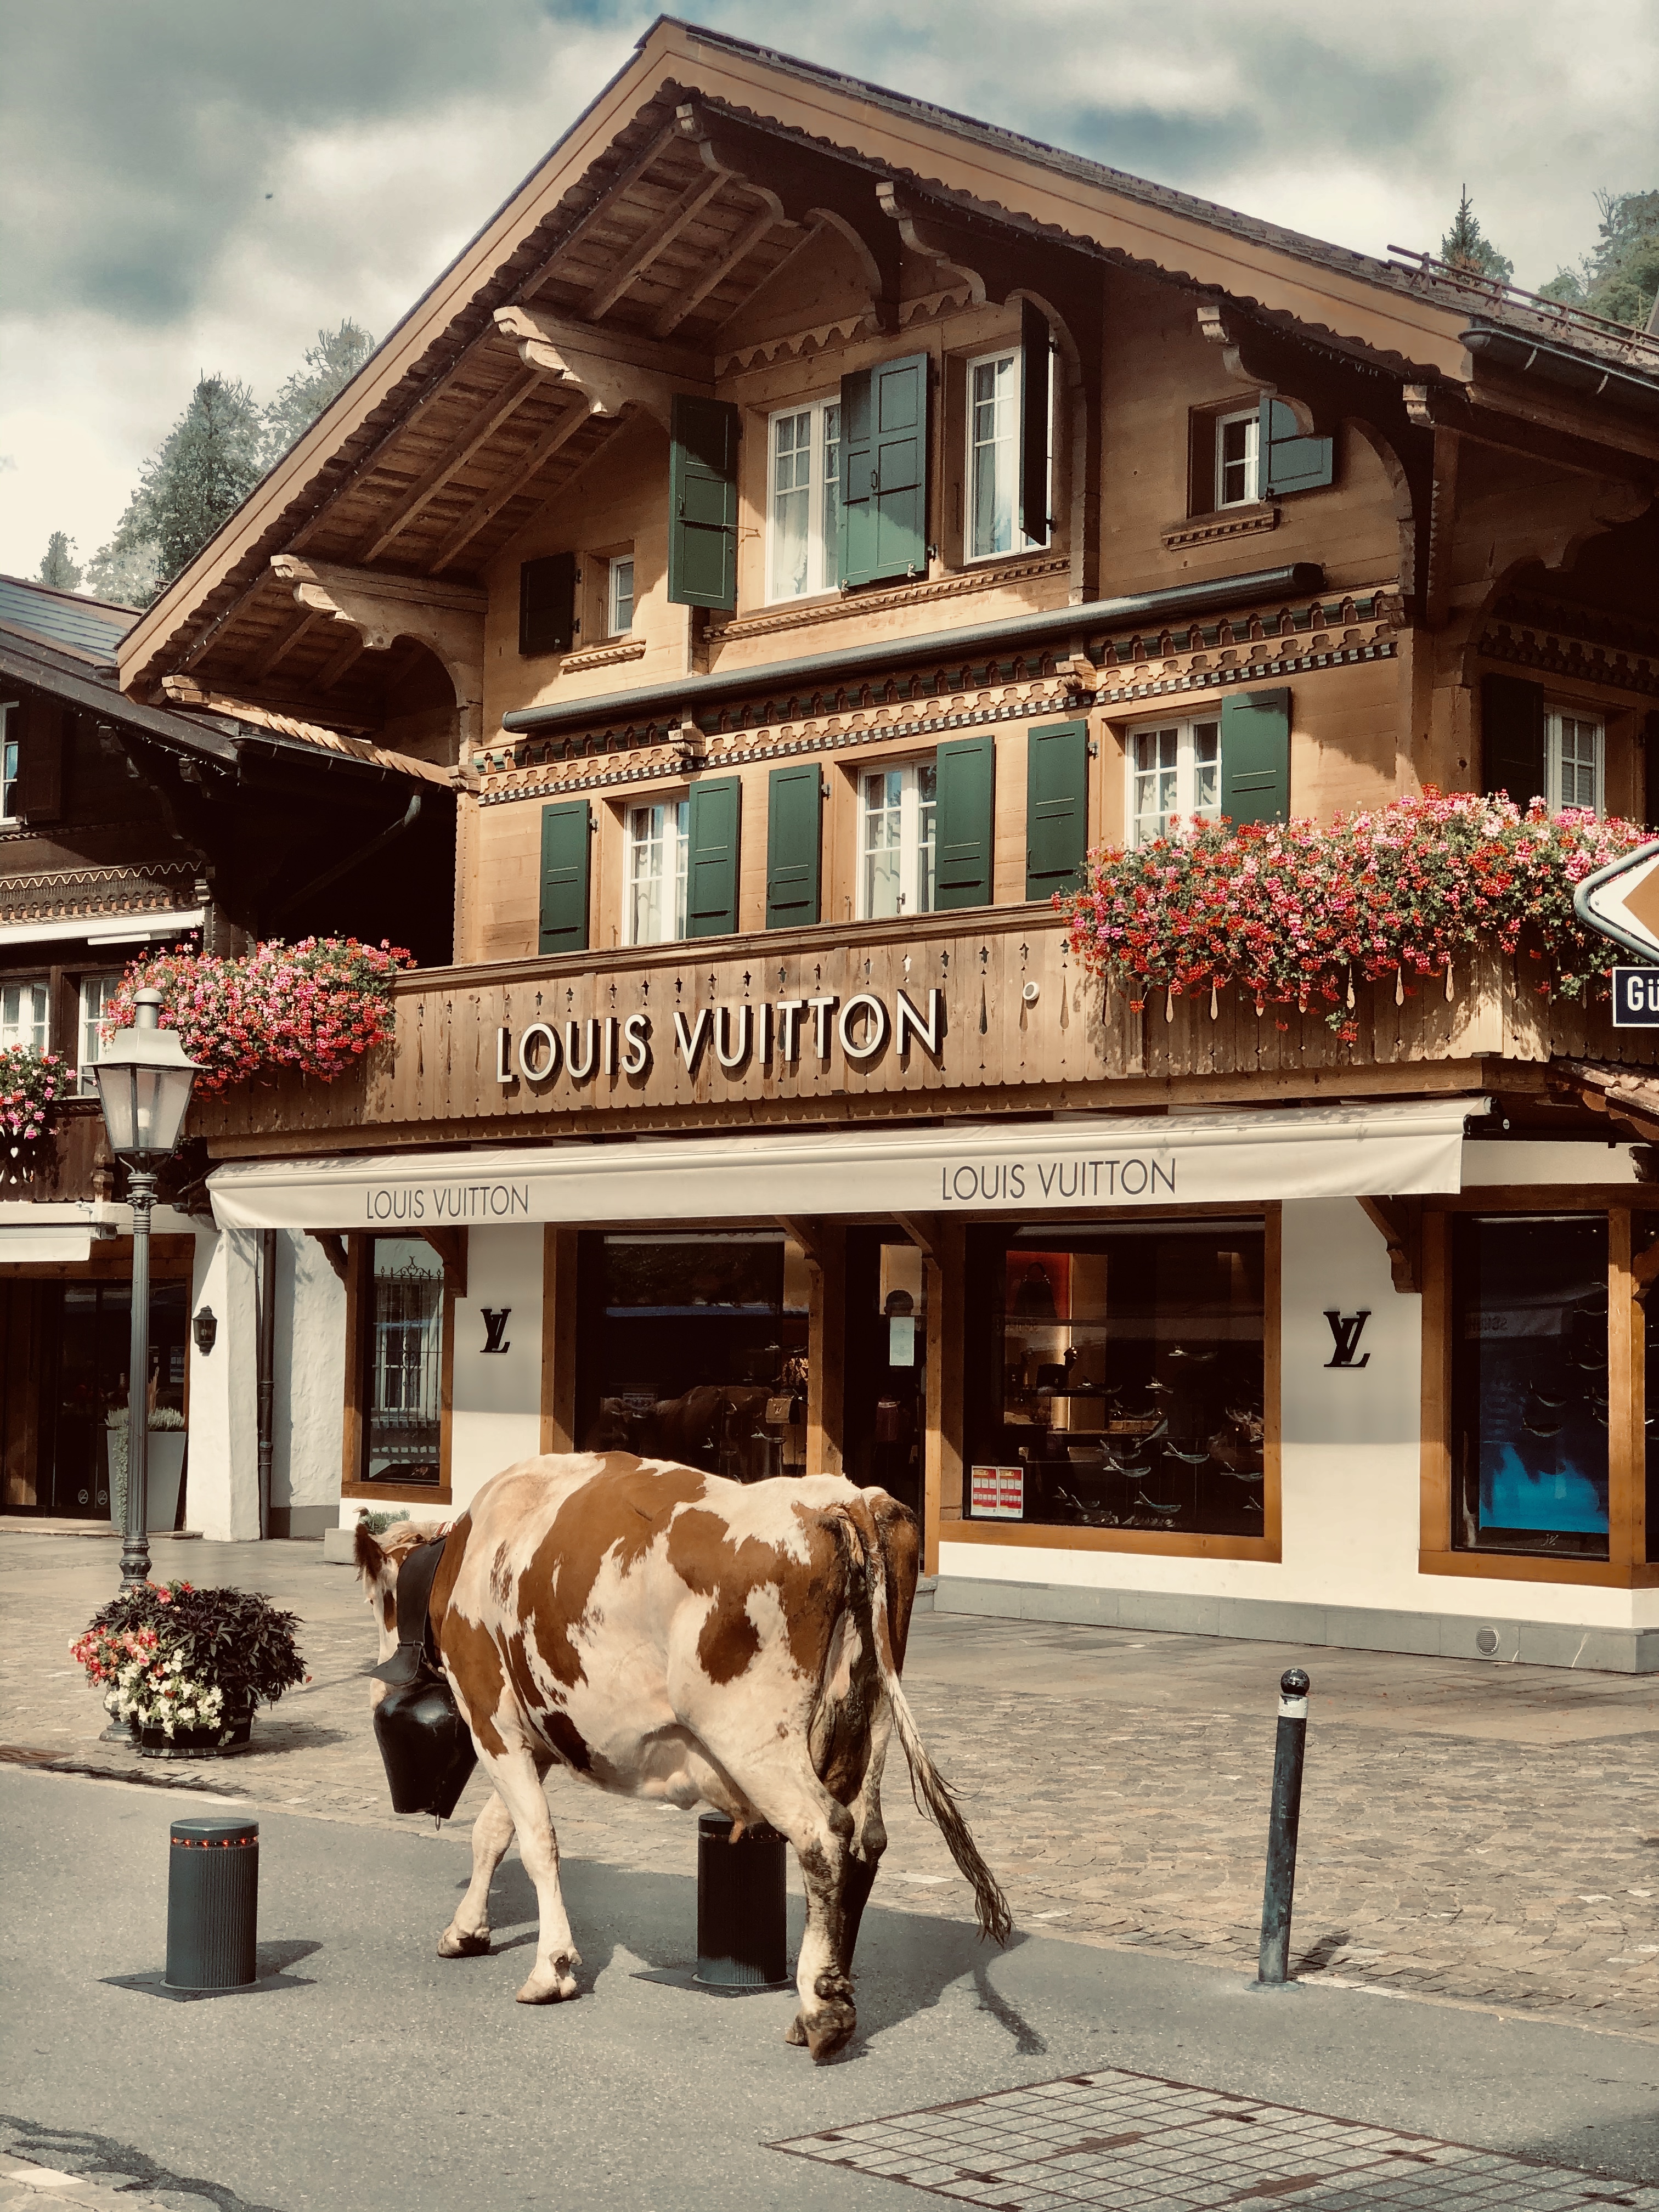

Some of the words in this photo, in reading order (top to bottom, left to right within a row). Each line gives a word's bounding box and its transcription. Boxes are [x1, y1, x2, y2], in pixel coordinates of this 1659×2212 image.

[497, 1014, 651, 1084] LOUIS
[673, 989, 942, 1073] VUITTON
[942, 1164, 1026, 1200] LOUIS
[1037, 1158, 1176, 1199] VUITTON
[367, 1189, 425, 1220] LOUIS
[433, 1184, 529, 1218] VUITTON
